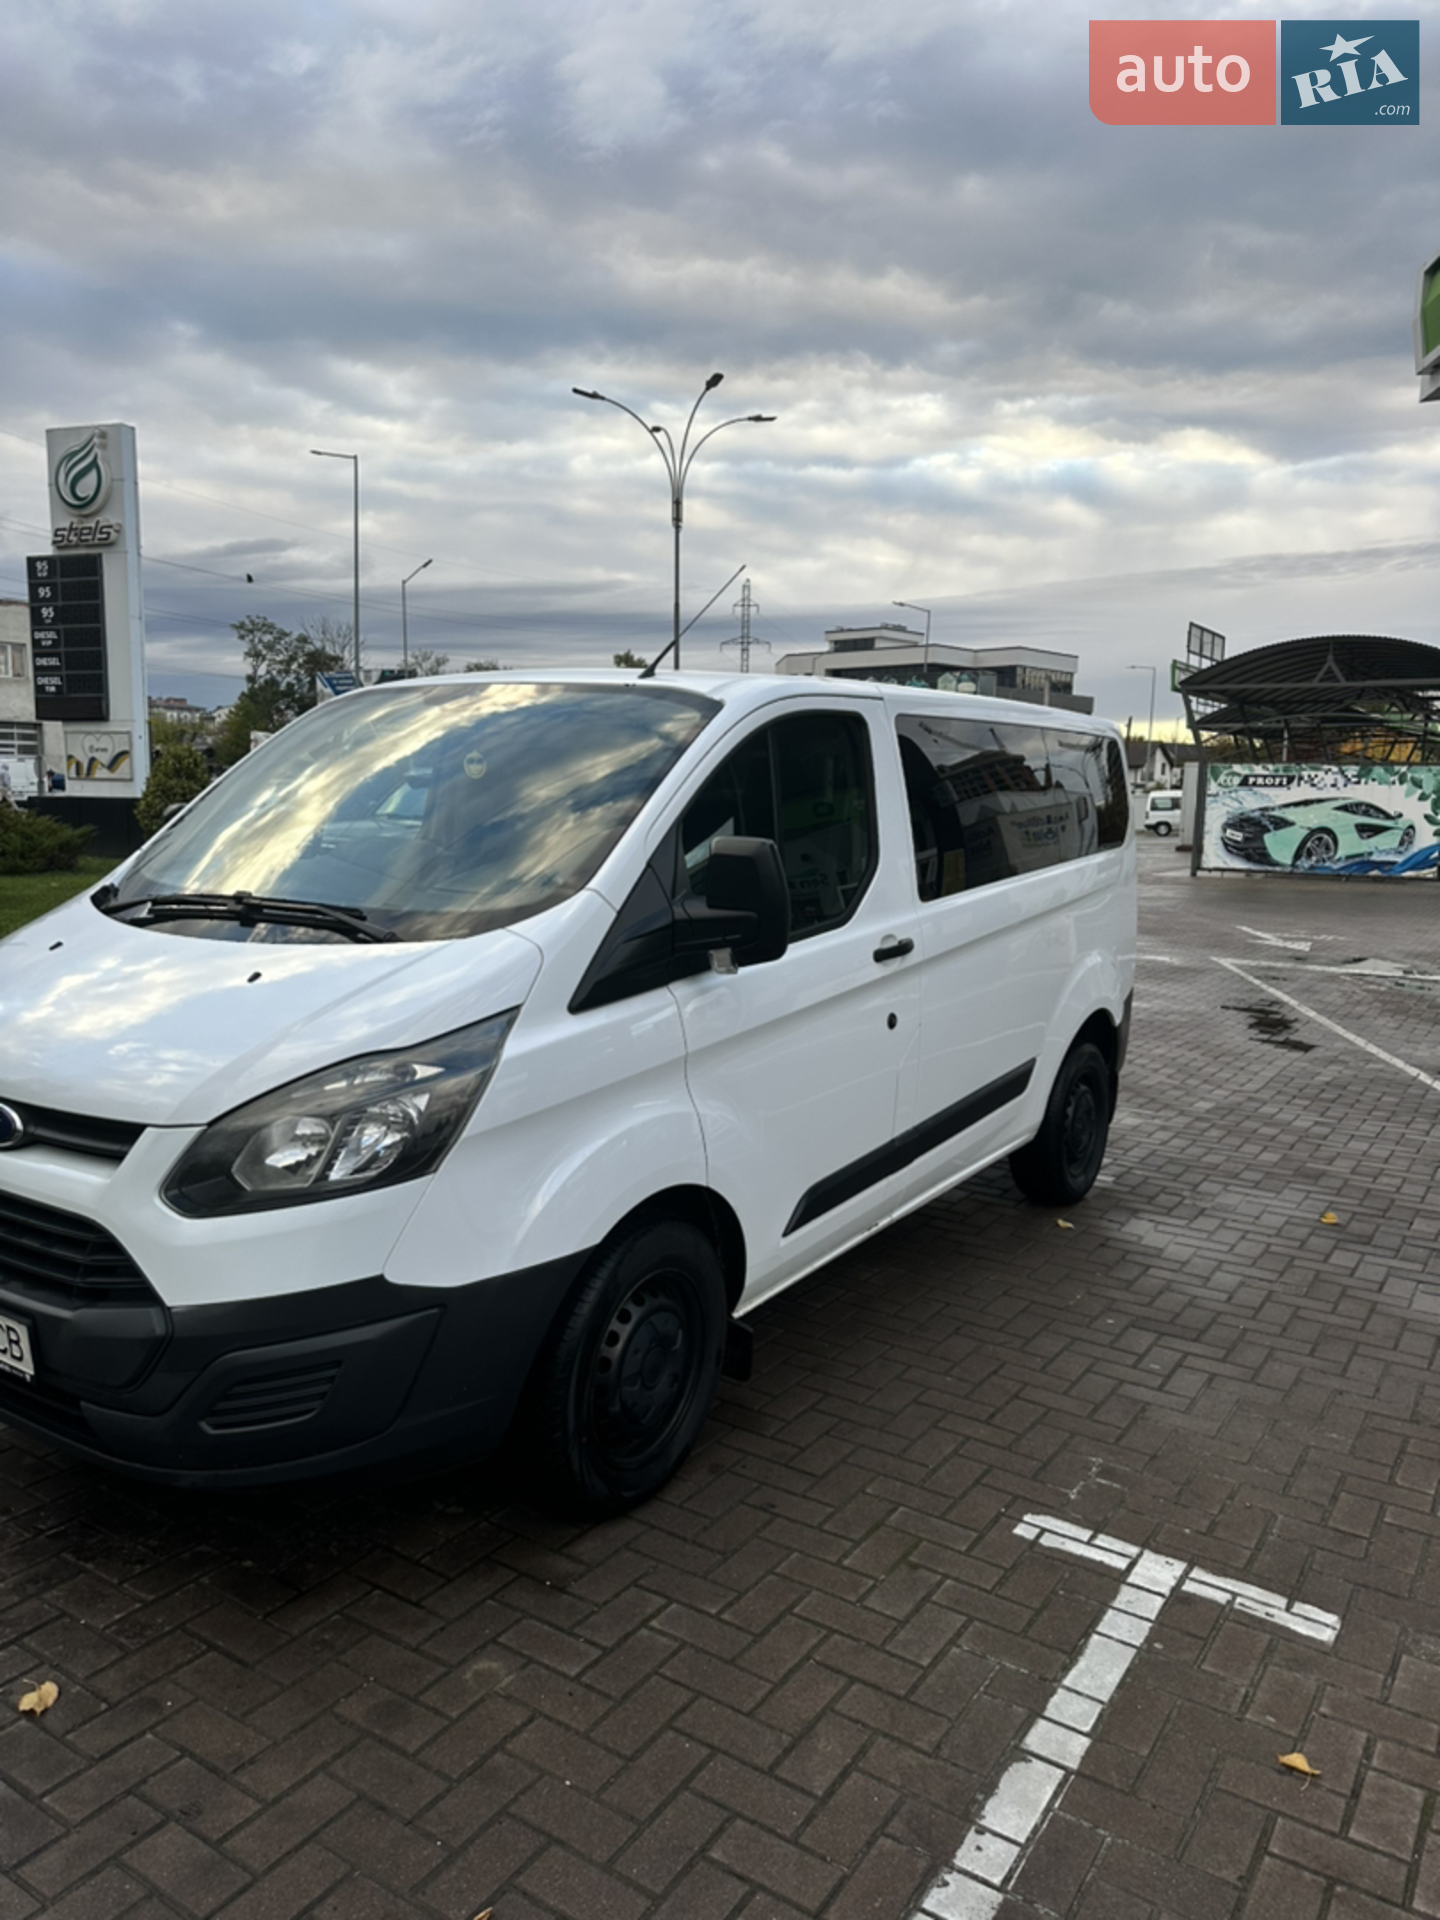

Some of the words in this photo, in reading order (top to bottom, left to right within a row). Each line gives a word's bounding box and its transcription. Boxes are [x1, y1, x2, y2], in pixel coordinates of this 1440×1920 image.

[52, 519, 113, 544] stels
[35, 560, 49, 572] 95
[38, 586, 52, 598] 95
[41, 606, 54, 618] 95
[33, 631, 58, 639] DIESEL
[35, 657, 61, 666] DIESEL
[36, 676, 63, 685] DIESEL
